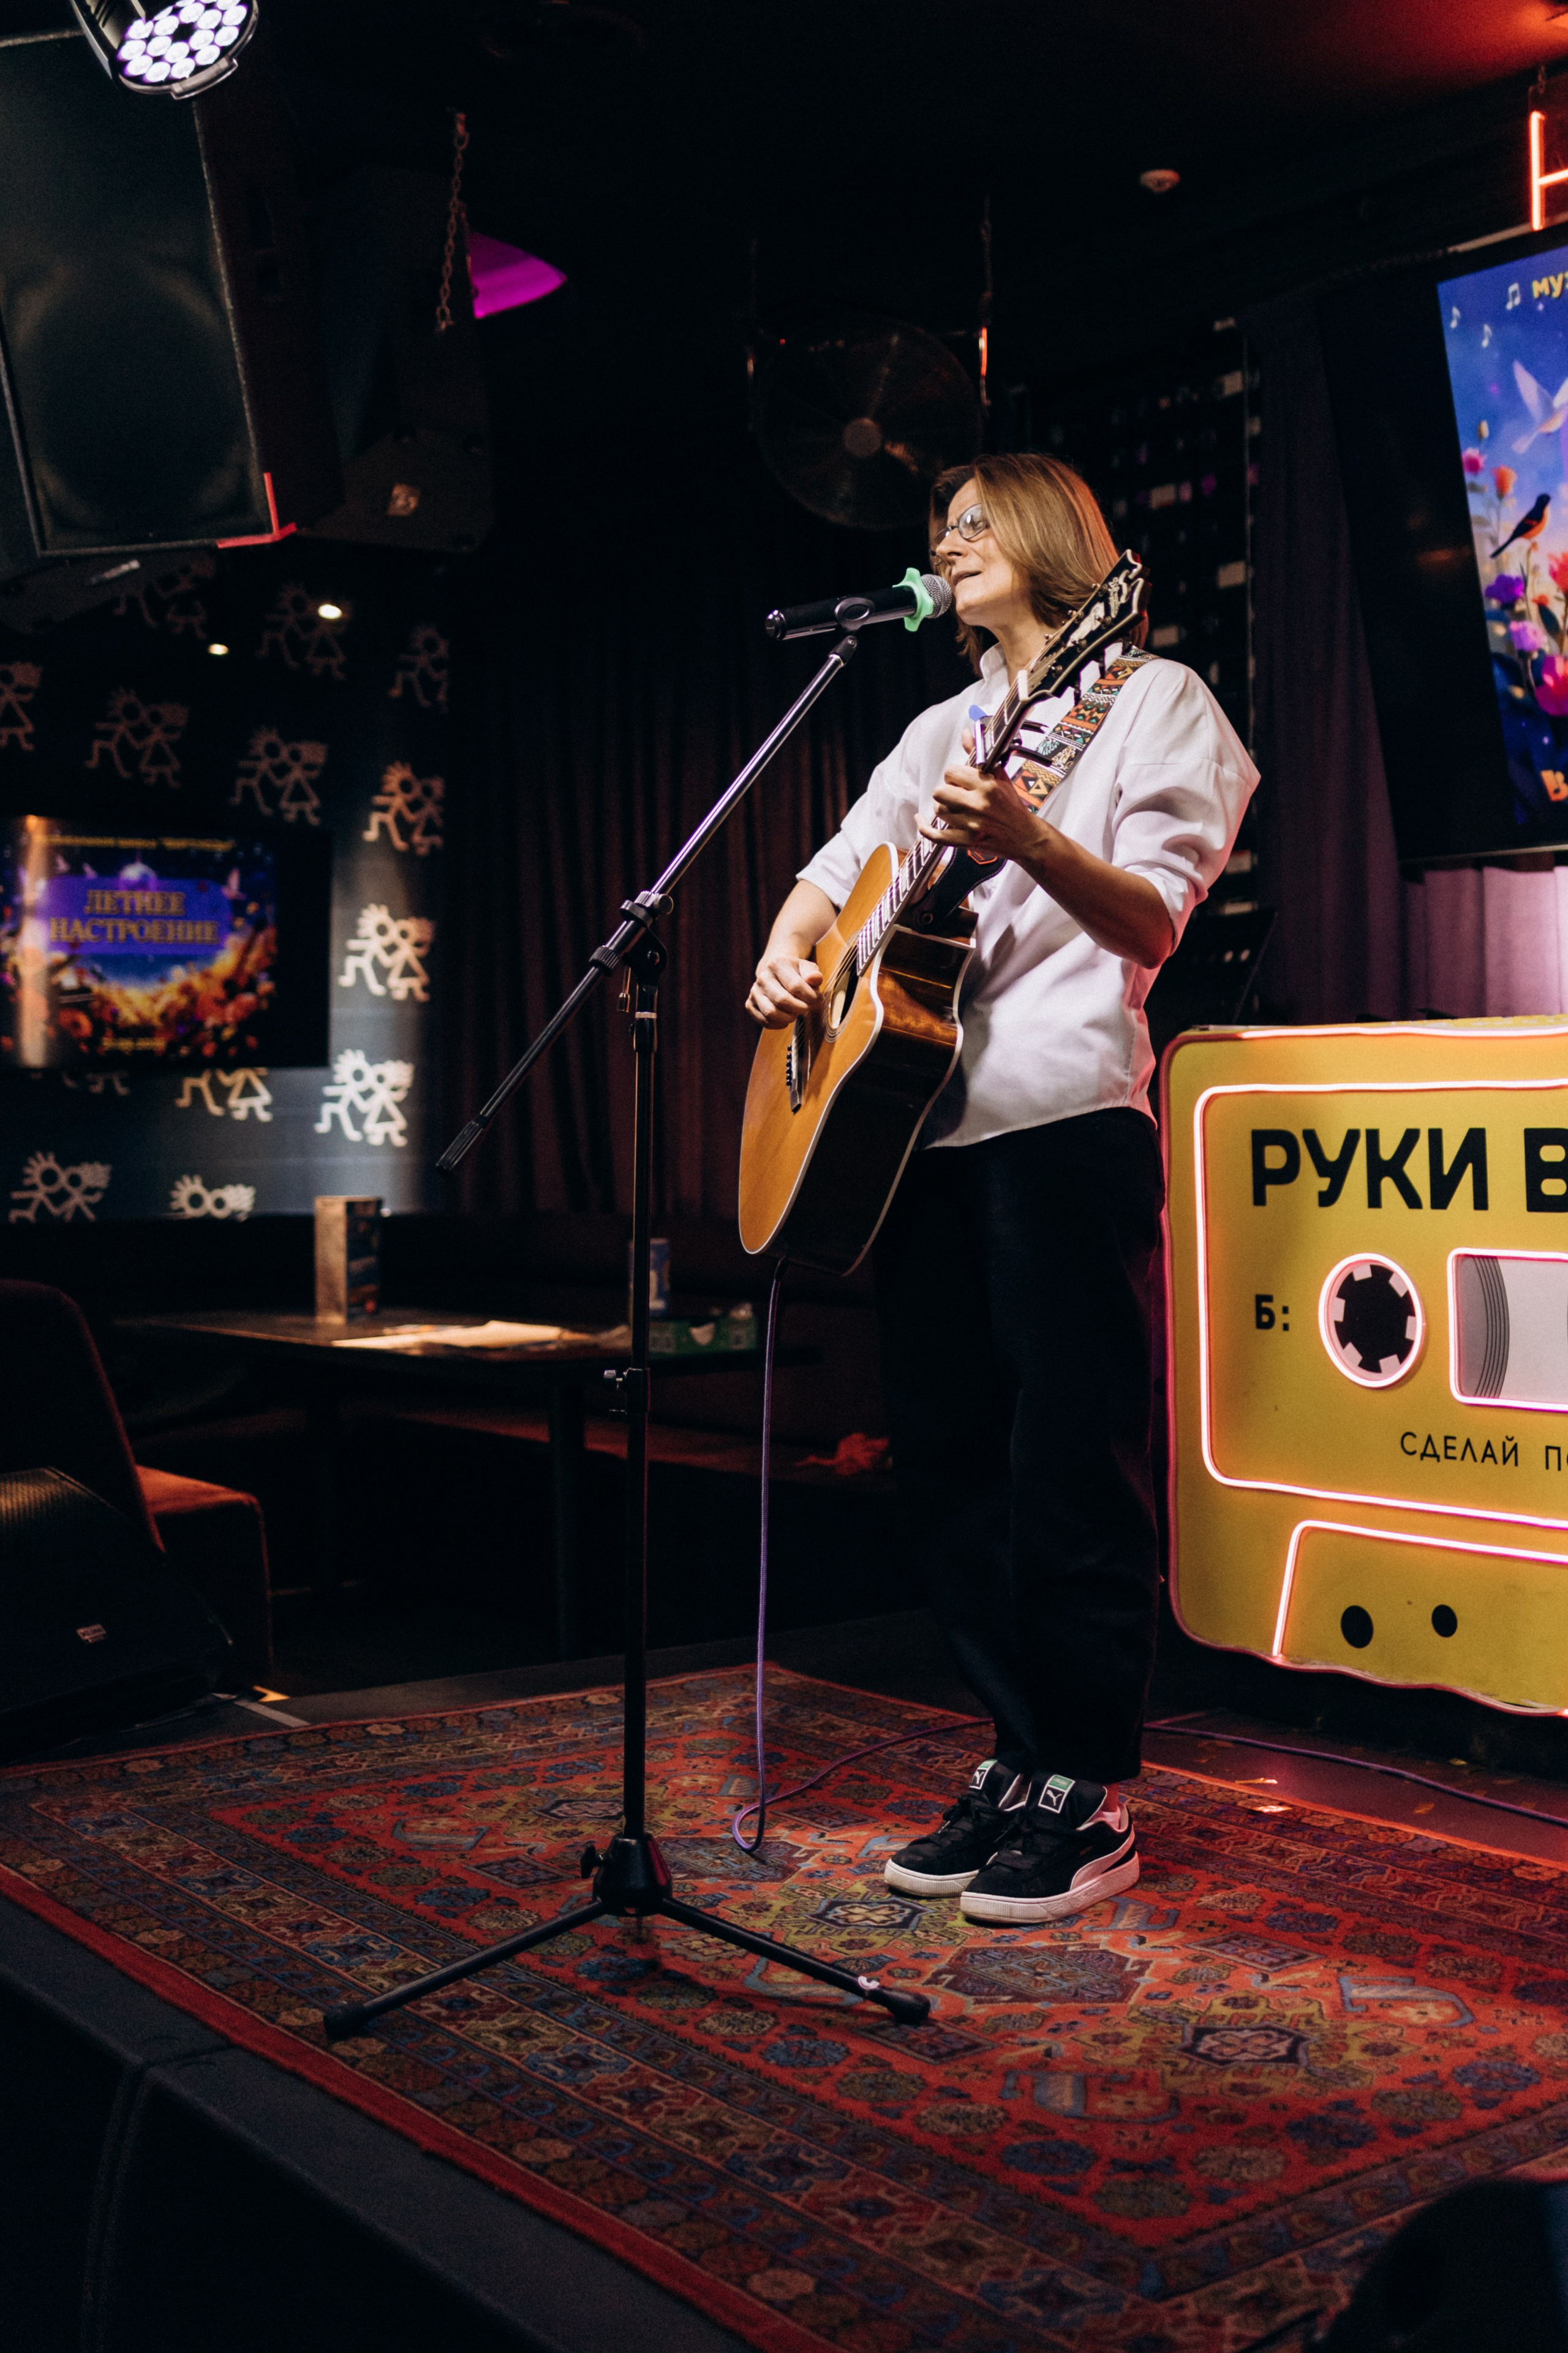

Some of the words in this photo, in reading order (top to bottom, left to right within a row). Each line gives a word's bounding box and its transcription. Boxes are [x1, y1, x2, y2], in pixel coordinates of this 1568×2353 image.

[85, 889, 186, 916] ЛЕТНЕЕ
[49, 916, 220, 945] НАСТРОЕНИЕ
[1251, 1128, 1489, 1210] РУКИ
[1255, 1294, 1289, 1332] Б:
[1401, 1430, 1518, 1467] СДЕЛАЙ
[1545, 1445, 1568, 1471] П
